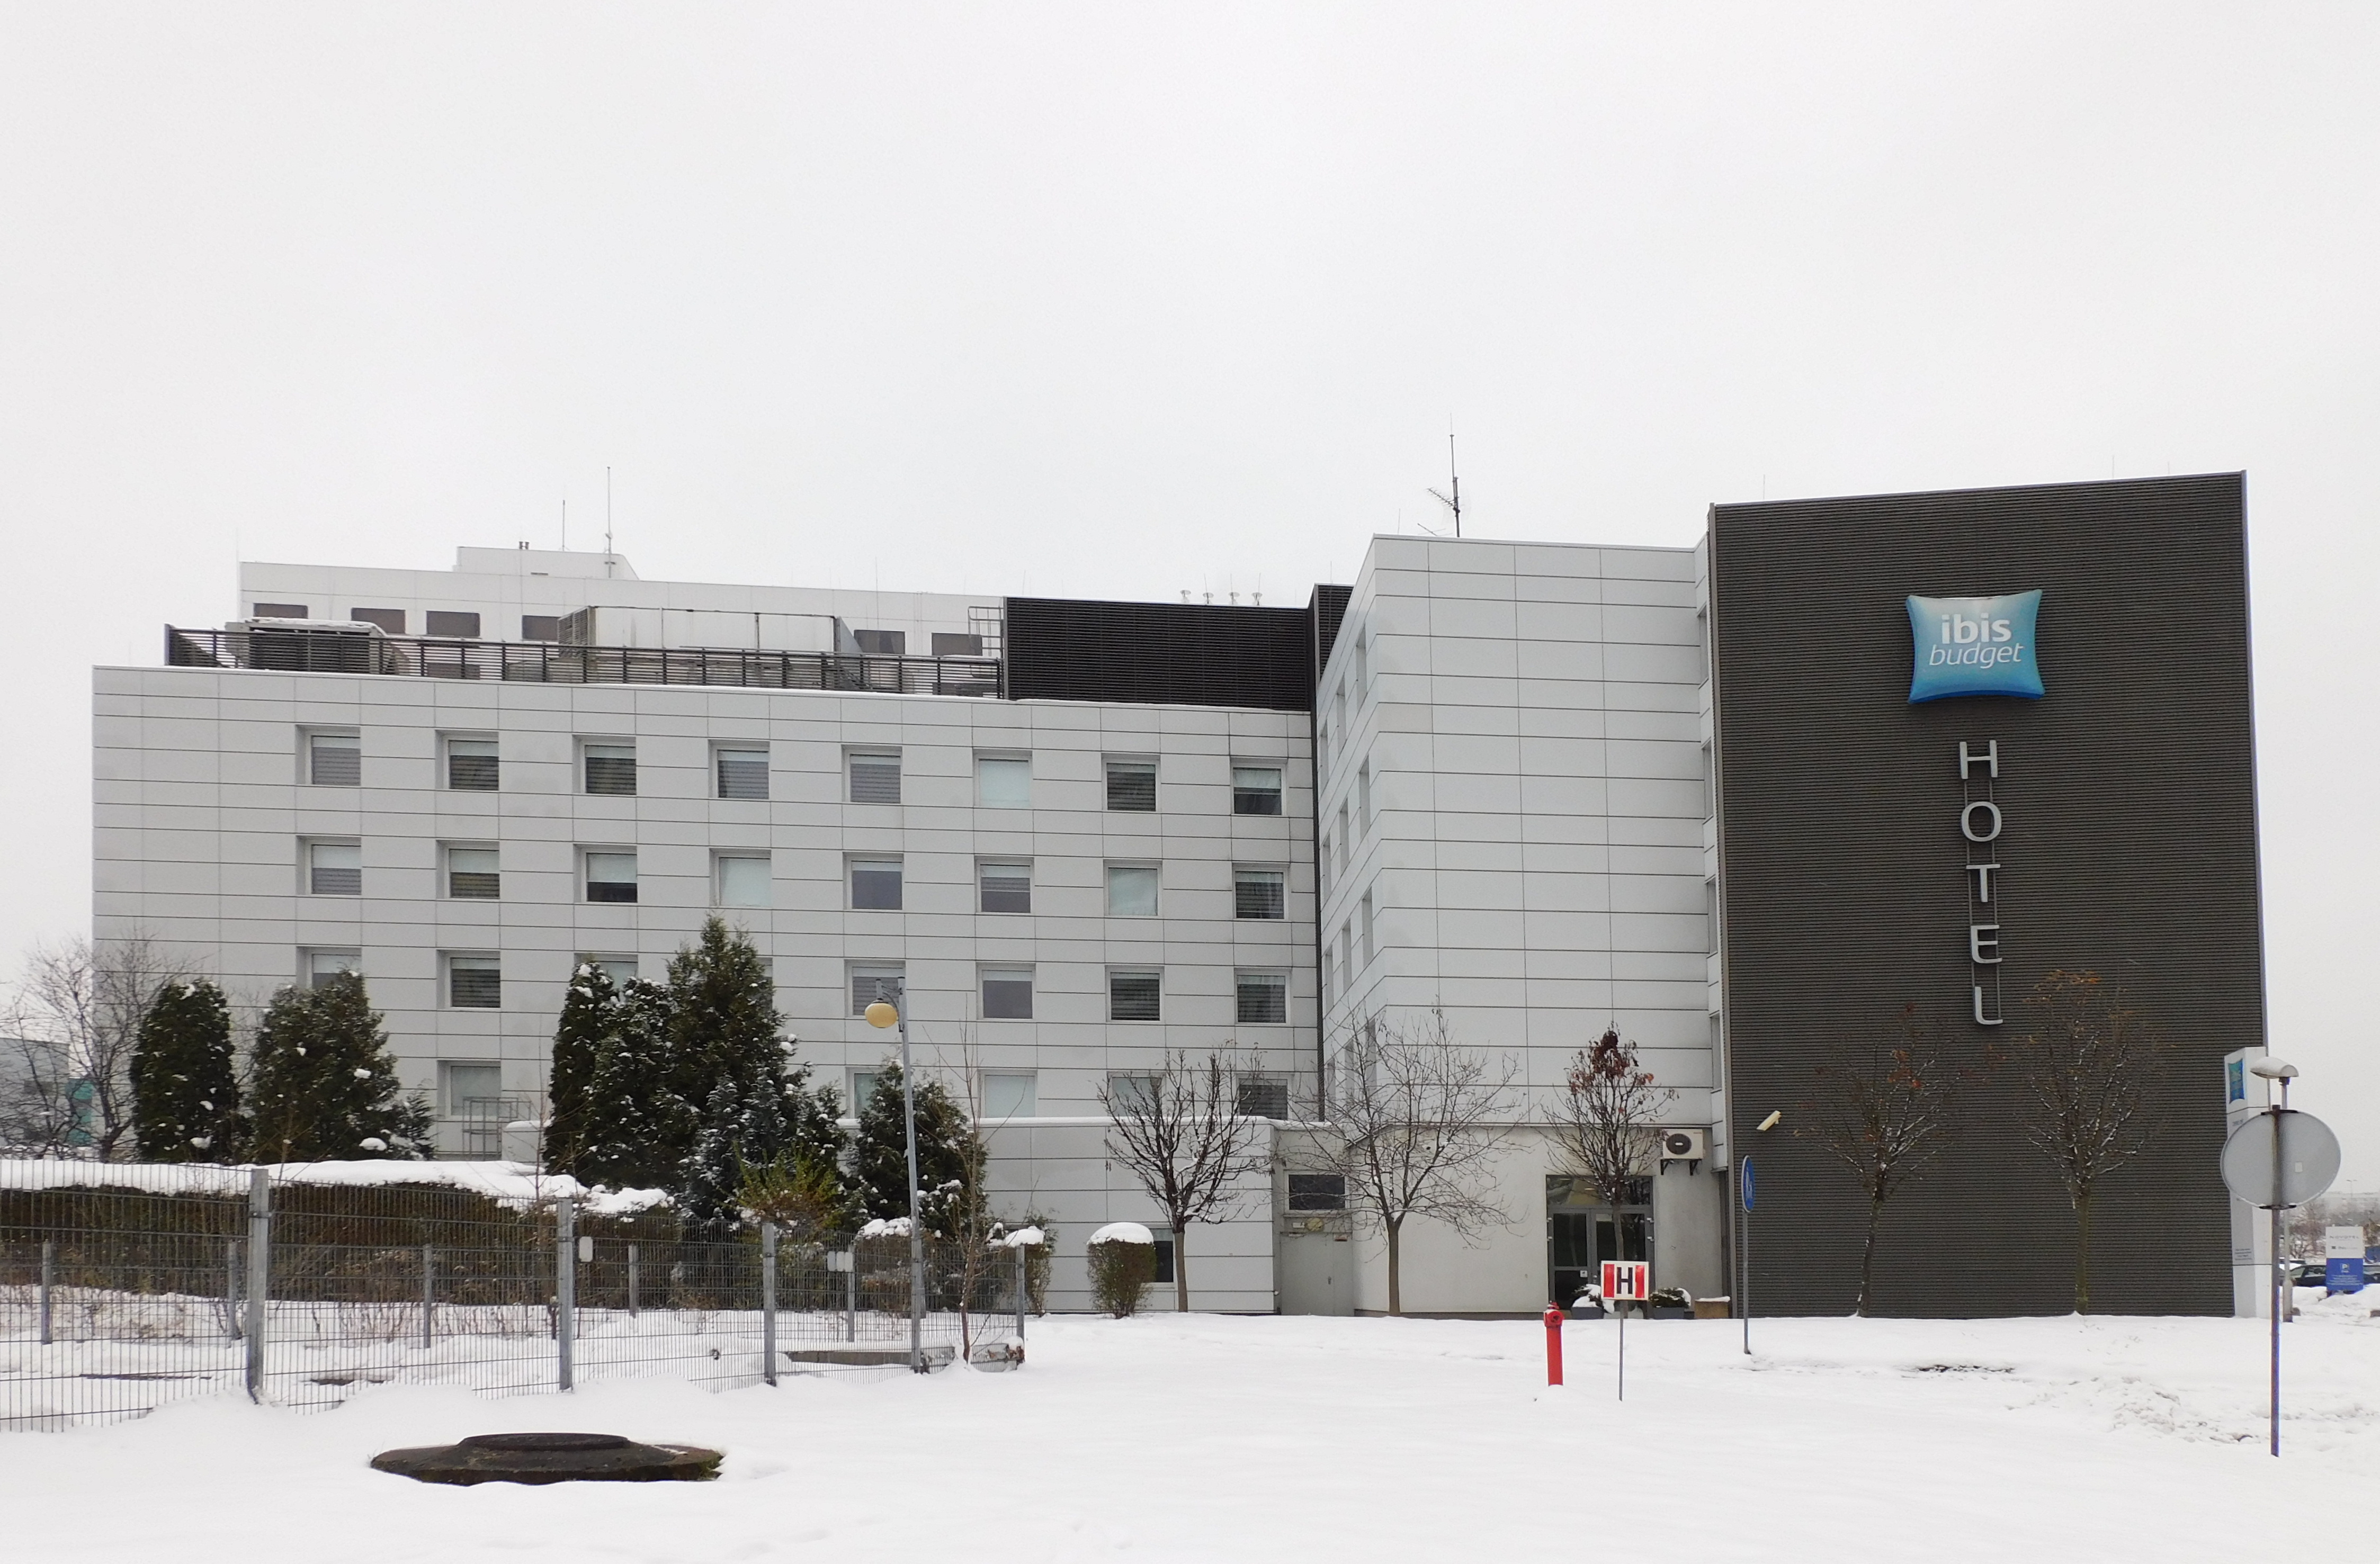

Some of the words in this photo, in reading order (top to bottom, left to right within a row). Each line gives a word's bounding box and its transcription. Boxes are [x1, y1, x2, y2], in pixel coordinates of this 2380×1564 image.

[1941, 613, 2011, 644] ibis
[1929, 643, 2025, 669] budget
[1960, 740, 2003, 1026] HOTEL
[1616, 1266, 1633, 1295] H
